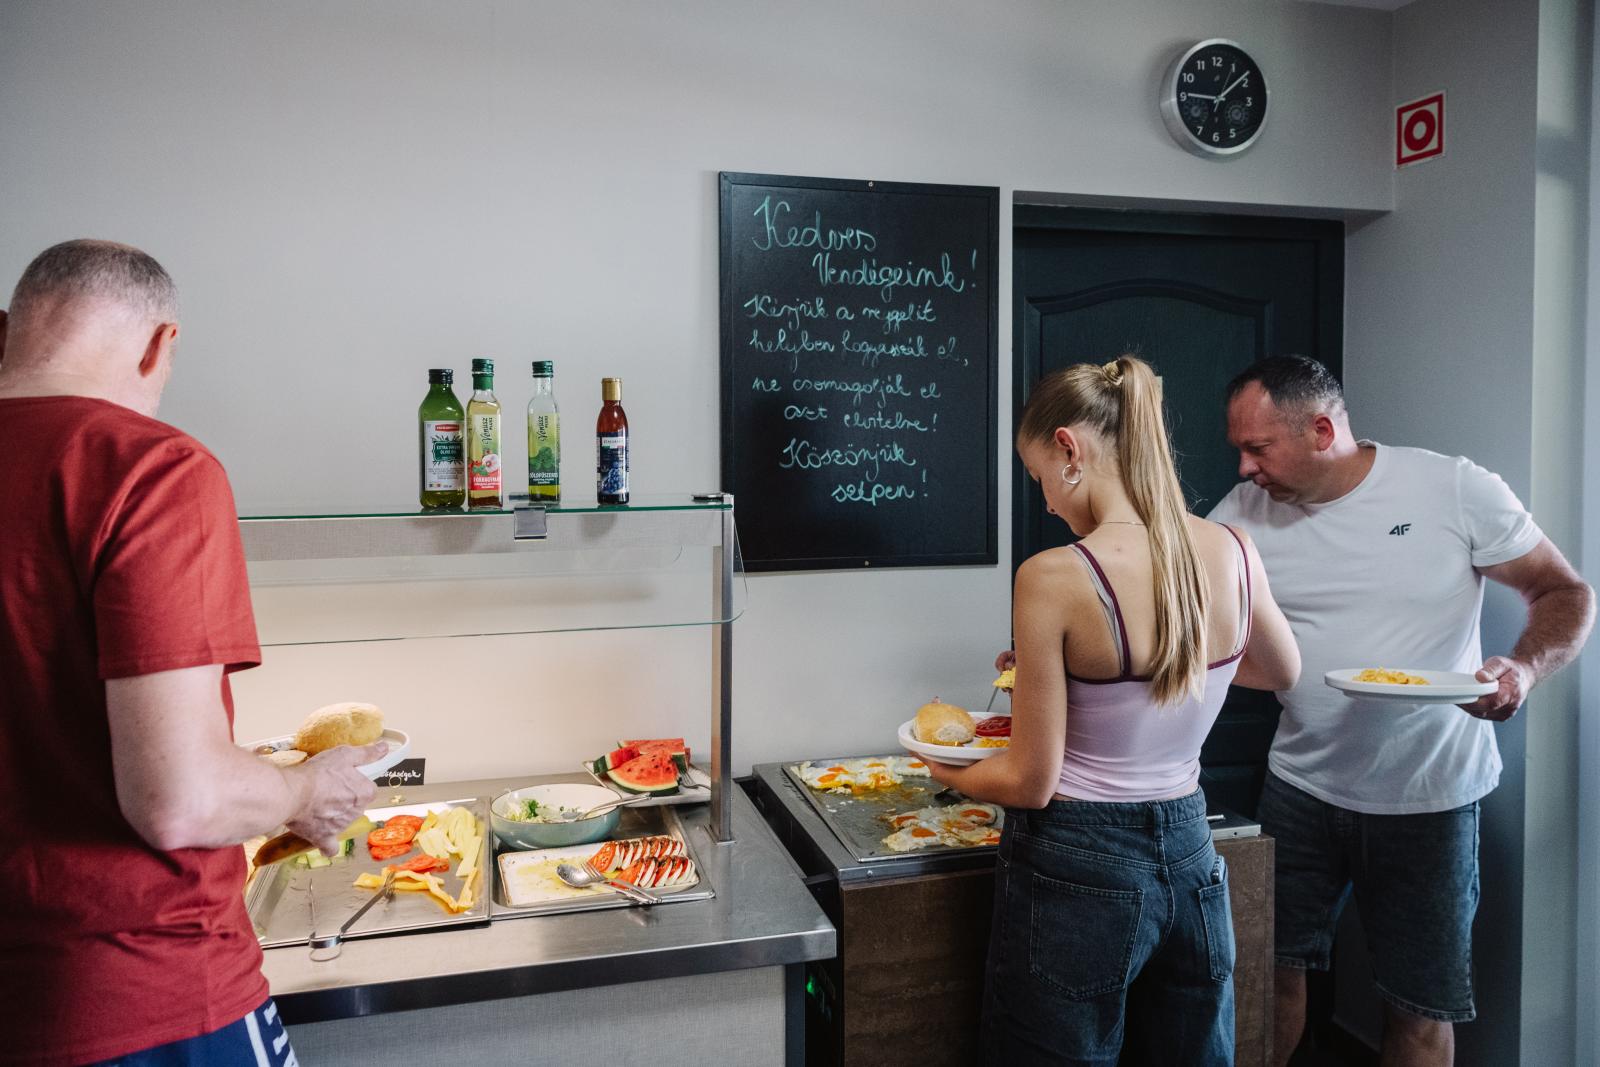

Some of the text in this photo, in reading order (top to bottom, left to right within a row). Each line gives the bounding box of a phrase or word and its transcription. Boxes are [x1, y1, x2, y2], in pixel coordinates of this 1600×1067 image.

[1197, 60, 1205, 70] 11
[1212, 56, 1223, 67] 12
[1231, 63, 1236, 73] 1
[1182, 72, 1195, 83] 10
[1242, 77, 1249, 88] 2
[1180, 91, 1187, 102] 9
[1245, 96, 1253, 107] 3
[1196, 126, 1204, 136] 7
[1229, 128, 1236, 138] 5
[1212, 132, 1220, 143] 6
[752, 196, 876, 251] Kedves
[836, 306, 855, 320] a
[862, 299, 936, 334] reggelit
[750, 328, 835, 373] helyben
[752, 376, 782, 392] ne
[920, 382, 941, 399] el
[784, 405, 828, 420] azt
[779, 441, 917, 482] Köszönjük
